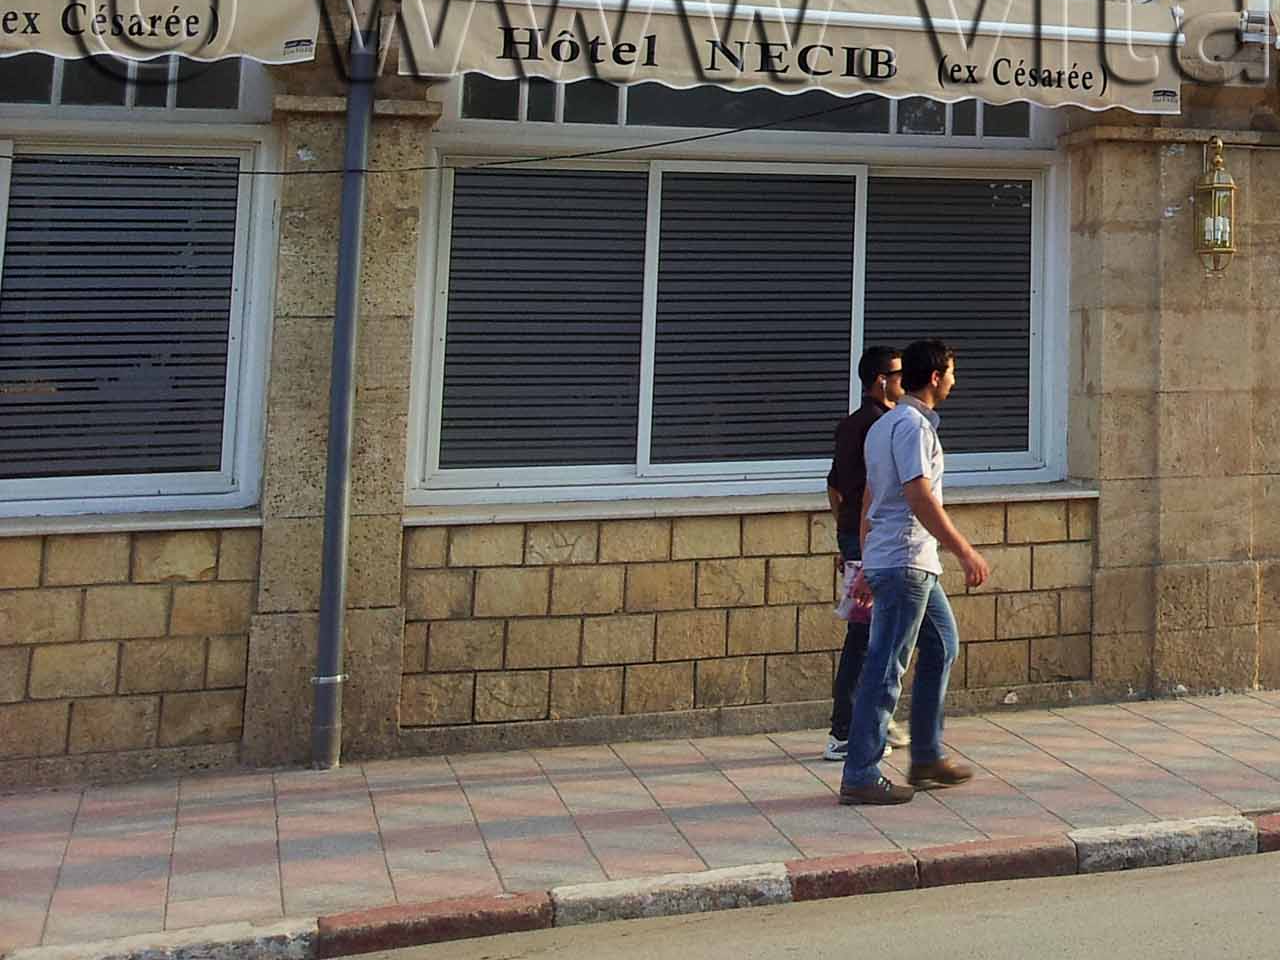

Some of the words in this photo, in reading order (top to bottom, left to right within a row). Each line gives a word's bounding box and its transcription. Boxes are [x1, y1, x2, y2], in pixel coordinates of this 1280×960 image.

[1, 9, 41, 35] ex
[61, 2, 220, 46] Césarée)
[495, 26, 659, 67] Hôtel
[704, 39, 898, 79] NECIB
[937, 54, 980, 89] (ex
[992, 57, 1108, 97] Césarée)
